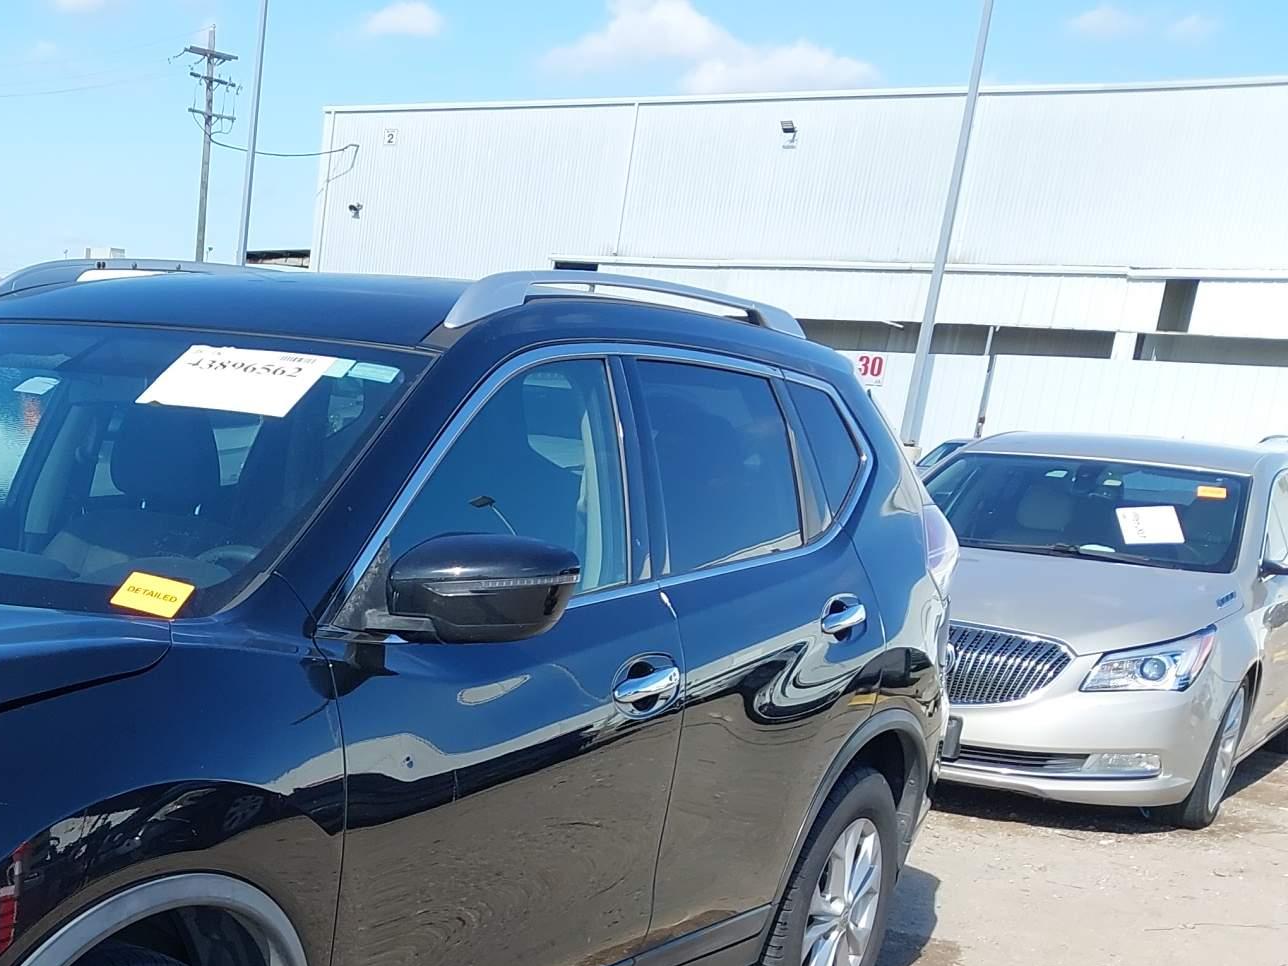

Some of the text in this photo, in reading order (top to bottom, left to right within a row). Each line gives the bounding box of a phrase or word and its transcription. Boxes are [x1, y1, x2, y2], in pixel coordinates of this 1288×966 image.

[387, 133, 394, 144] 2
[857, 355, 884, 377] 30
[127, 586, 178, 603] DETAILED
